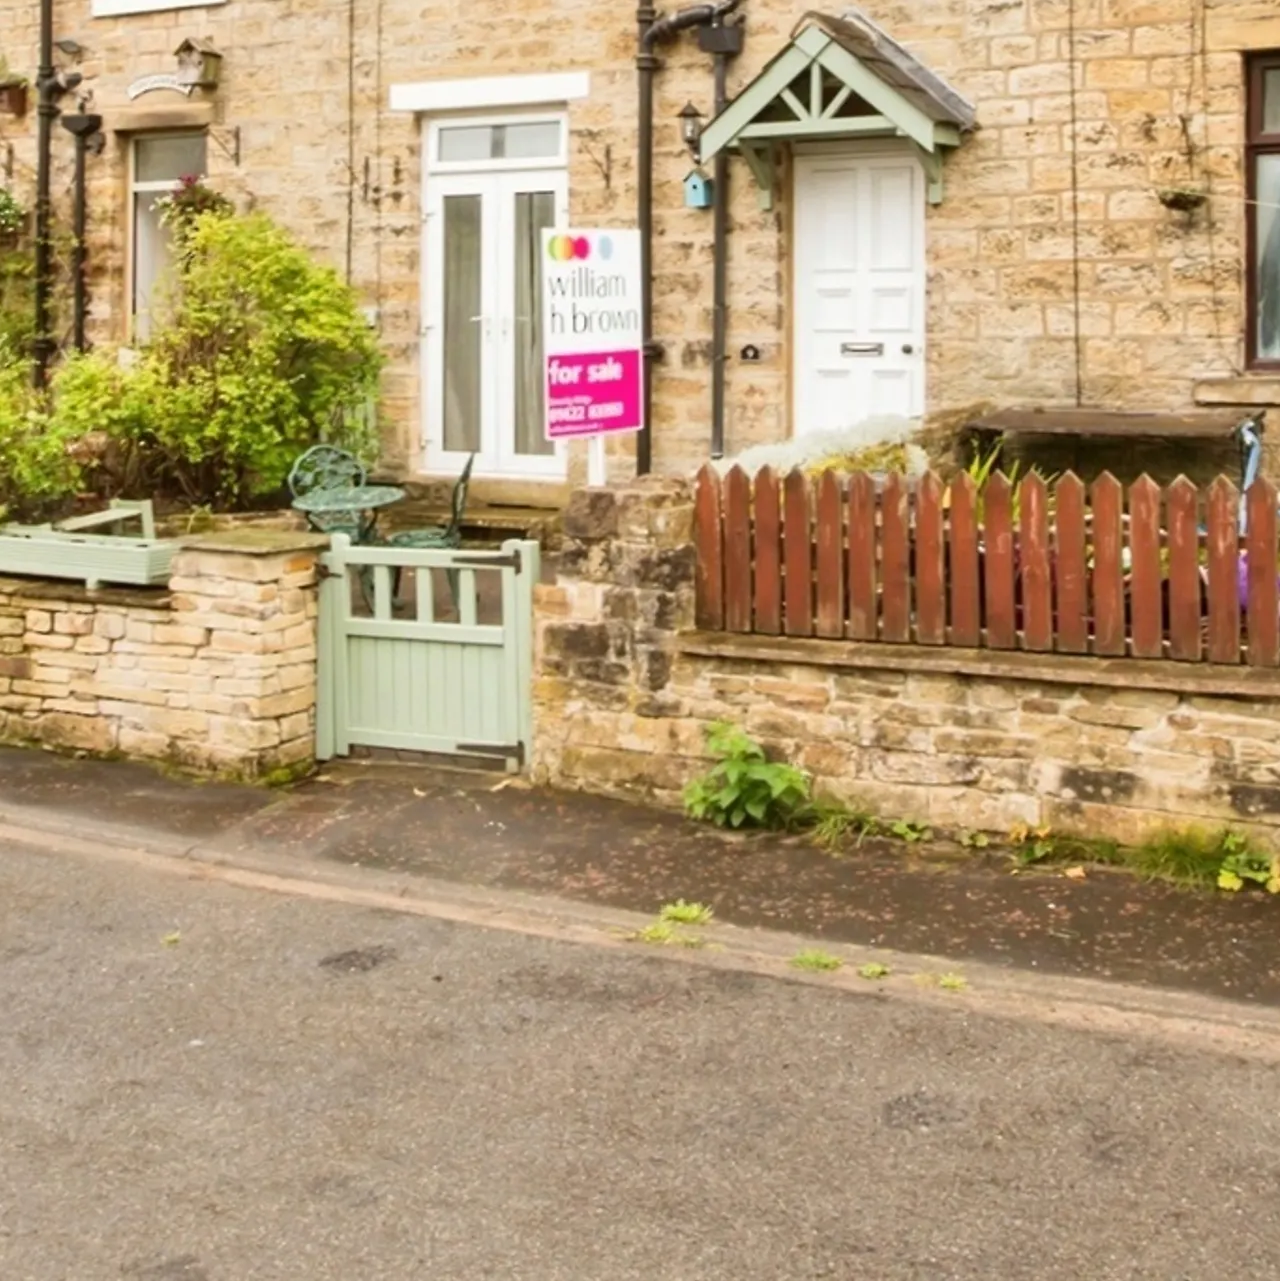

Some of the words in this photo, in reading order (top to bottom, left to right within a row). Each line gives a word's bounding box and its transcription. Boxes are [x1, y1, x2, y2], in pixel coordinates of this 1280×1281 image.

[548, 266, 626, 298] william
[550, 303, 565, 334] h
[572, 302, 638, 333] brown
[549, 360, 583, 385] for
[587, 356, 623, 383] sale
